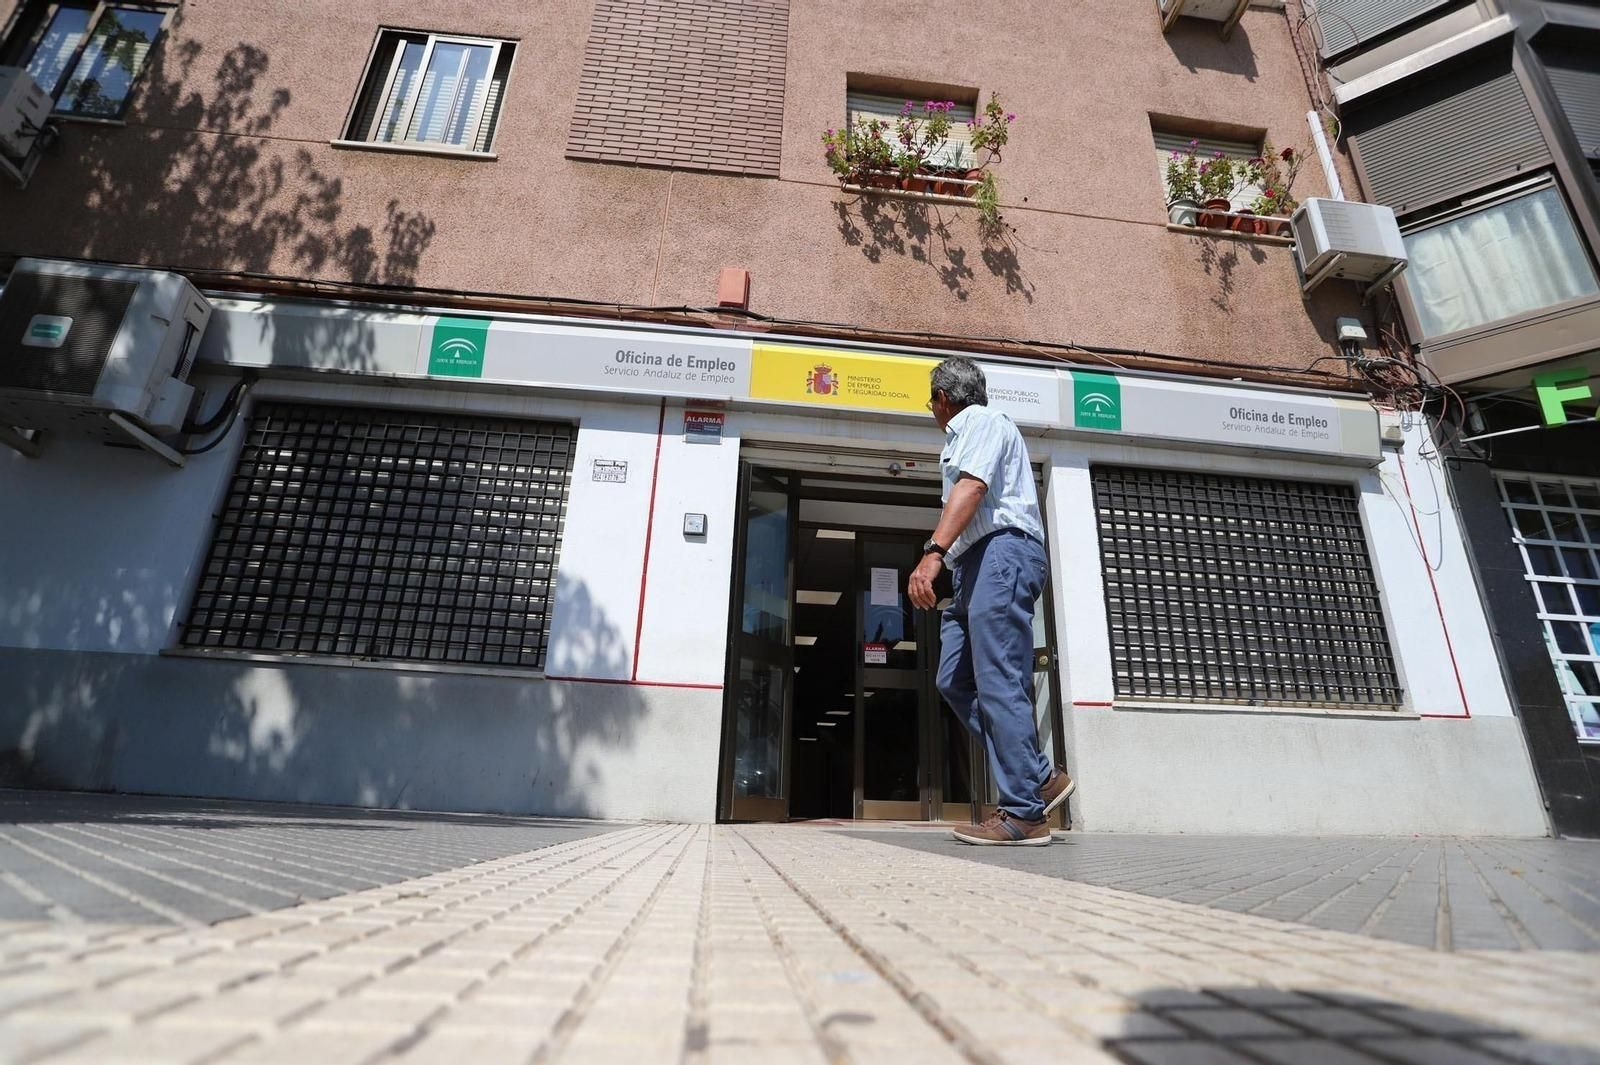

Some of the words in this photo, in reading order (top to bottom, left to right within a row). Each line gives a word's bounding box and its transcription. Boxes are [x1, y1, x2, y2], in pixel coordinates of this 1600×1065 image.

[615, 350, 662, 367] Oficina
[666, 354, 682, 367] de
[686, 355, 736, 371] Empleo
[604, 365, 639, 377] Servicio
[643, 368, 682, 380] Andaluz
[685, 371, 697, 381] de
[701, 372, 735, 385] Empleo
[853, 389, 887, 397] SEGURIDAD
[857, 382, 880, 390] EMPLEO
[987, 387, 1013, 395] SERVICIO
[1535, 367, 1600, 425] F
[686, 415, 722, 424] ALARMA
[1229, 407, 1269, 422] Oficina
[1271, 411, 1285, 424] de
[1289, 412, 1328, 428] Empleo
[1222, 420, 1252, 432] Servicio
[1254, 424, 1286, 436] Andaluz
[1288, 427, 1299, 437] de
[1301, 428, 1329, 440] Empleo
